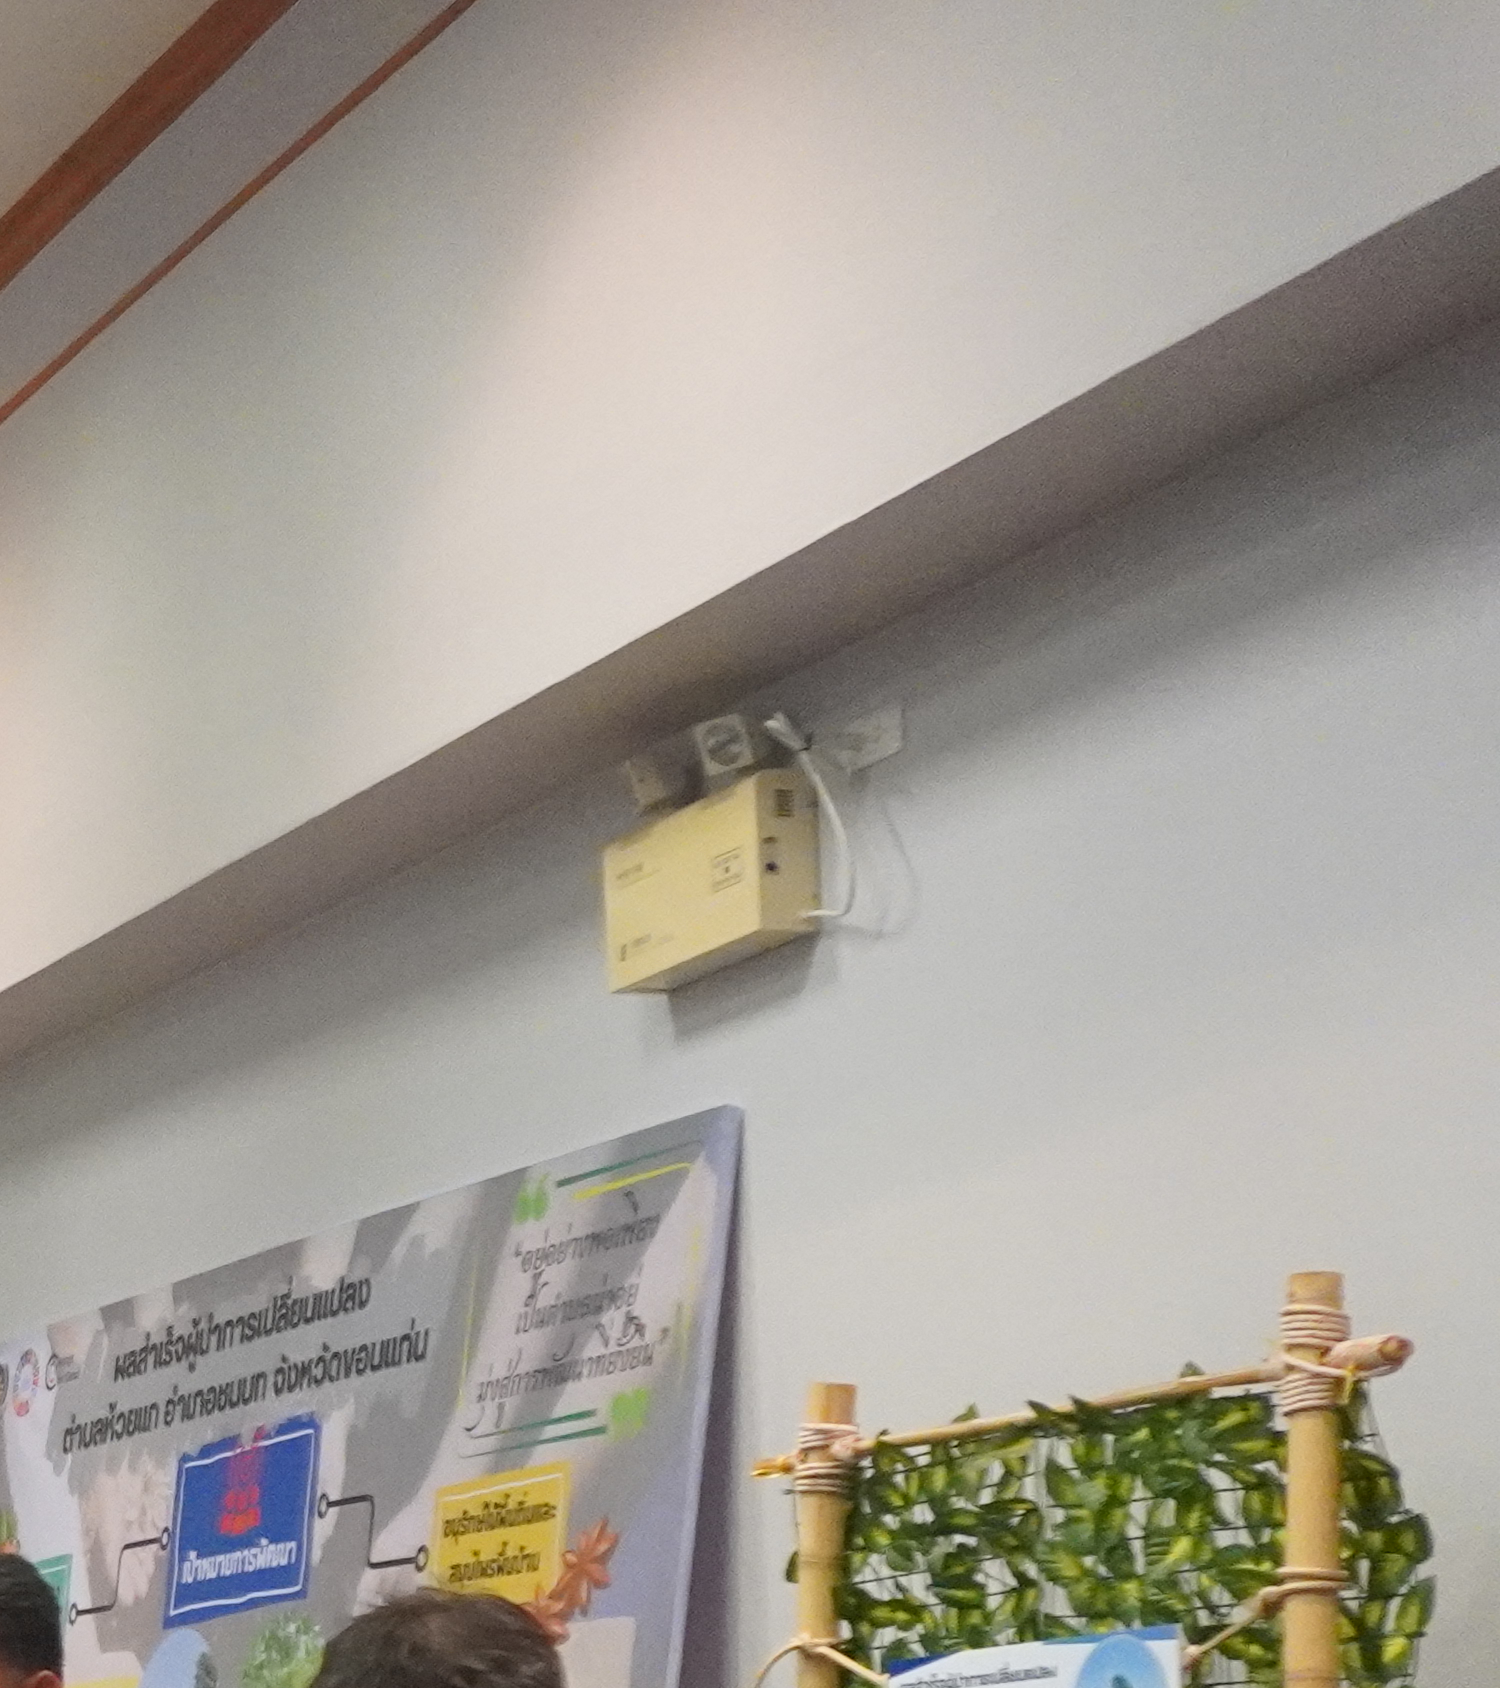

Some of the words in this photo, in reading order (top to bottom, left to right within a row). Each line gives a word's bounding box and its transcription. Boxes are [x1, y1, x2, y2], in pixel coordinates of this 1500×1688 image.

[273, 1317, 430, 1398] จังหวัดขอนแก่น
